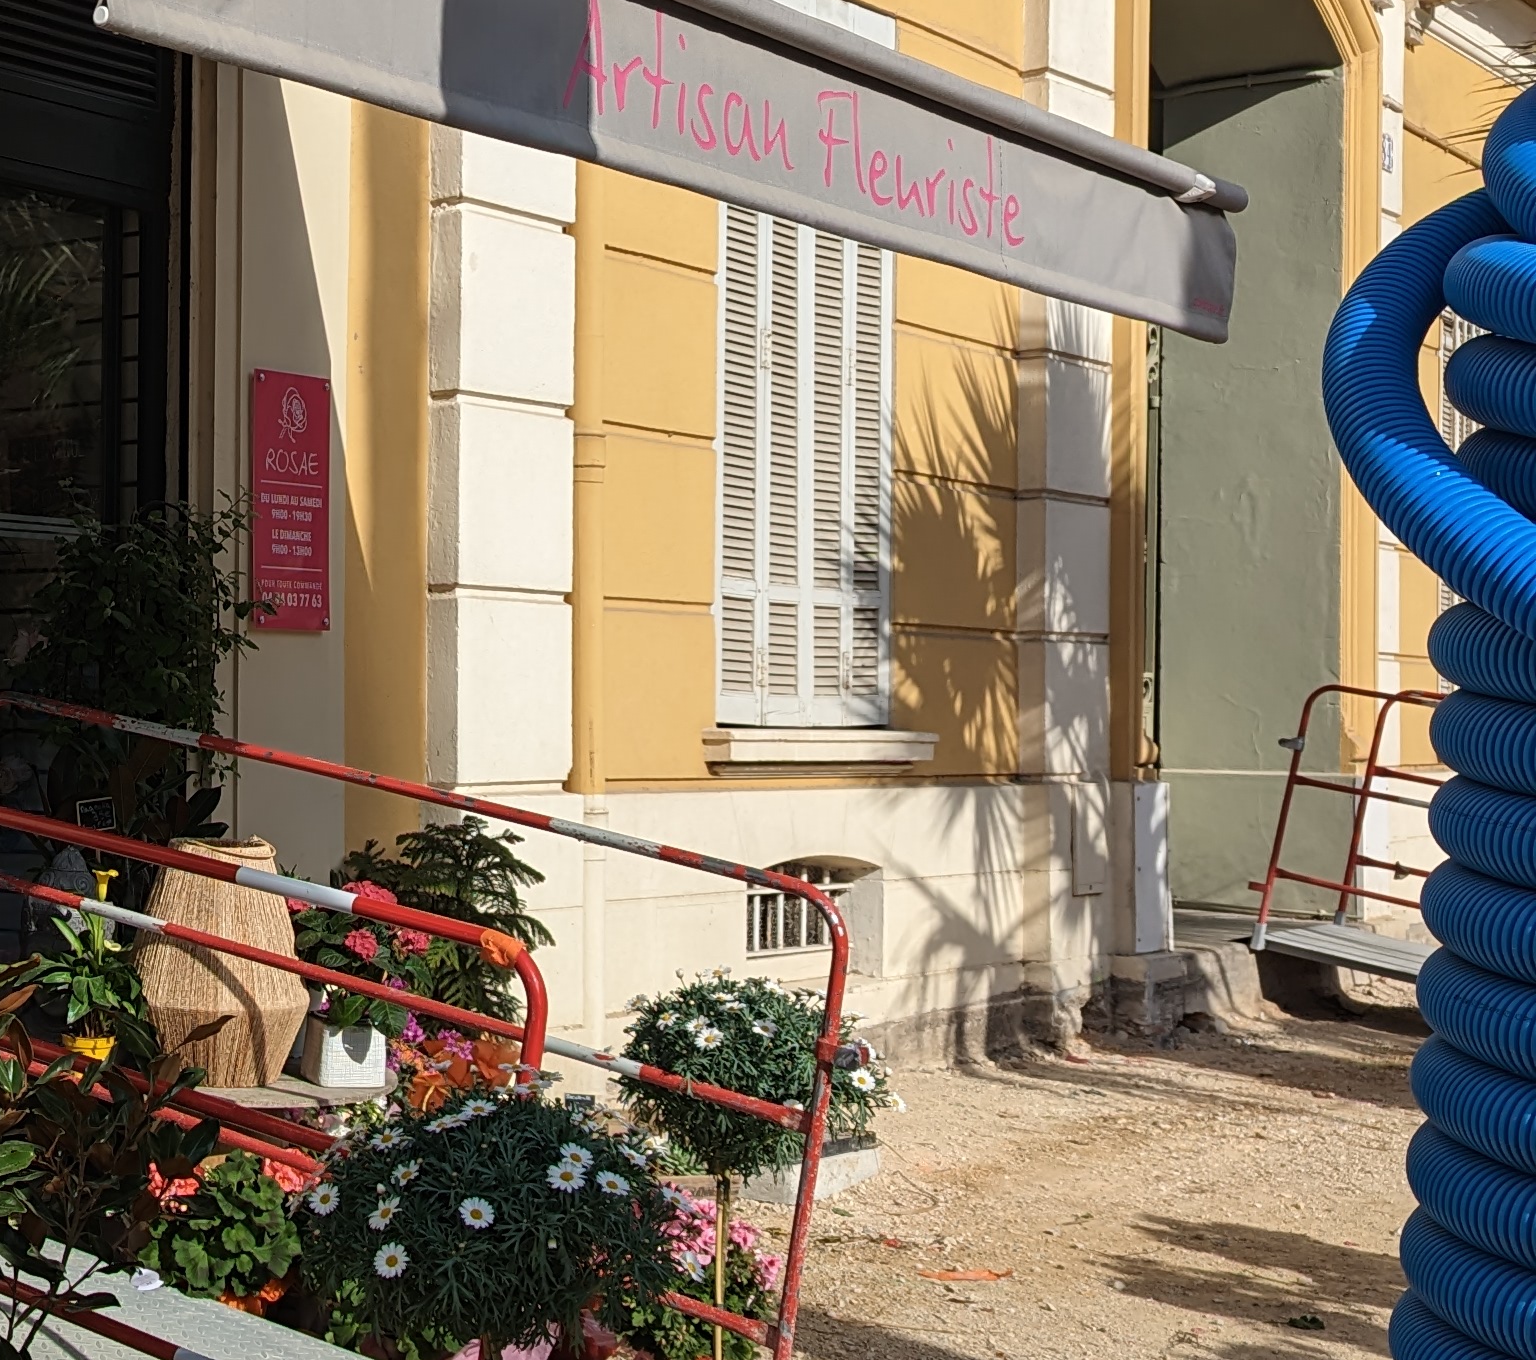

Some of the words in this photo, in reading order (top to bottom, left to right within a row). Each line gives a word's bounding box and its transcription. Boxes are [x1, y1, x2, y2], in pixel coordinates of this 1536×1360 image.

[817, 90, 1025, 248] Fleuriste
[265, 447, 319, 476] ROSAE
[260, 492, 270, 504] DU
[271, 493, 290, 505] LUNDI
[290, 495, 299, 506] AU
[299, 496, 323, 509] SAMEDI
[271, 528, 279, 540] LE
[279, 529, 312, 542] DIMANCHE
[287, 592, 298, 607] 03
[299, 593, 310, 607] 77
[311, 594, 322, 608] 63
